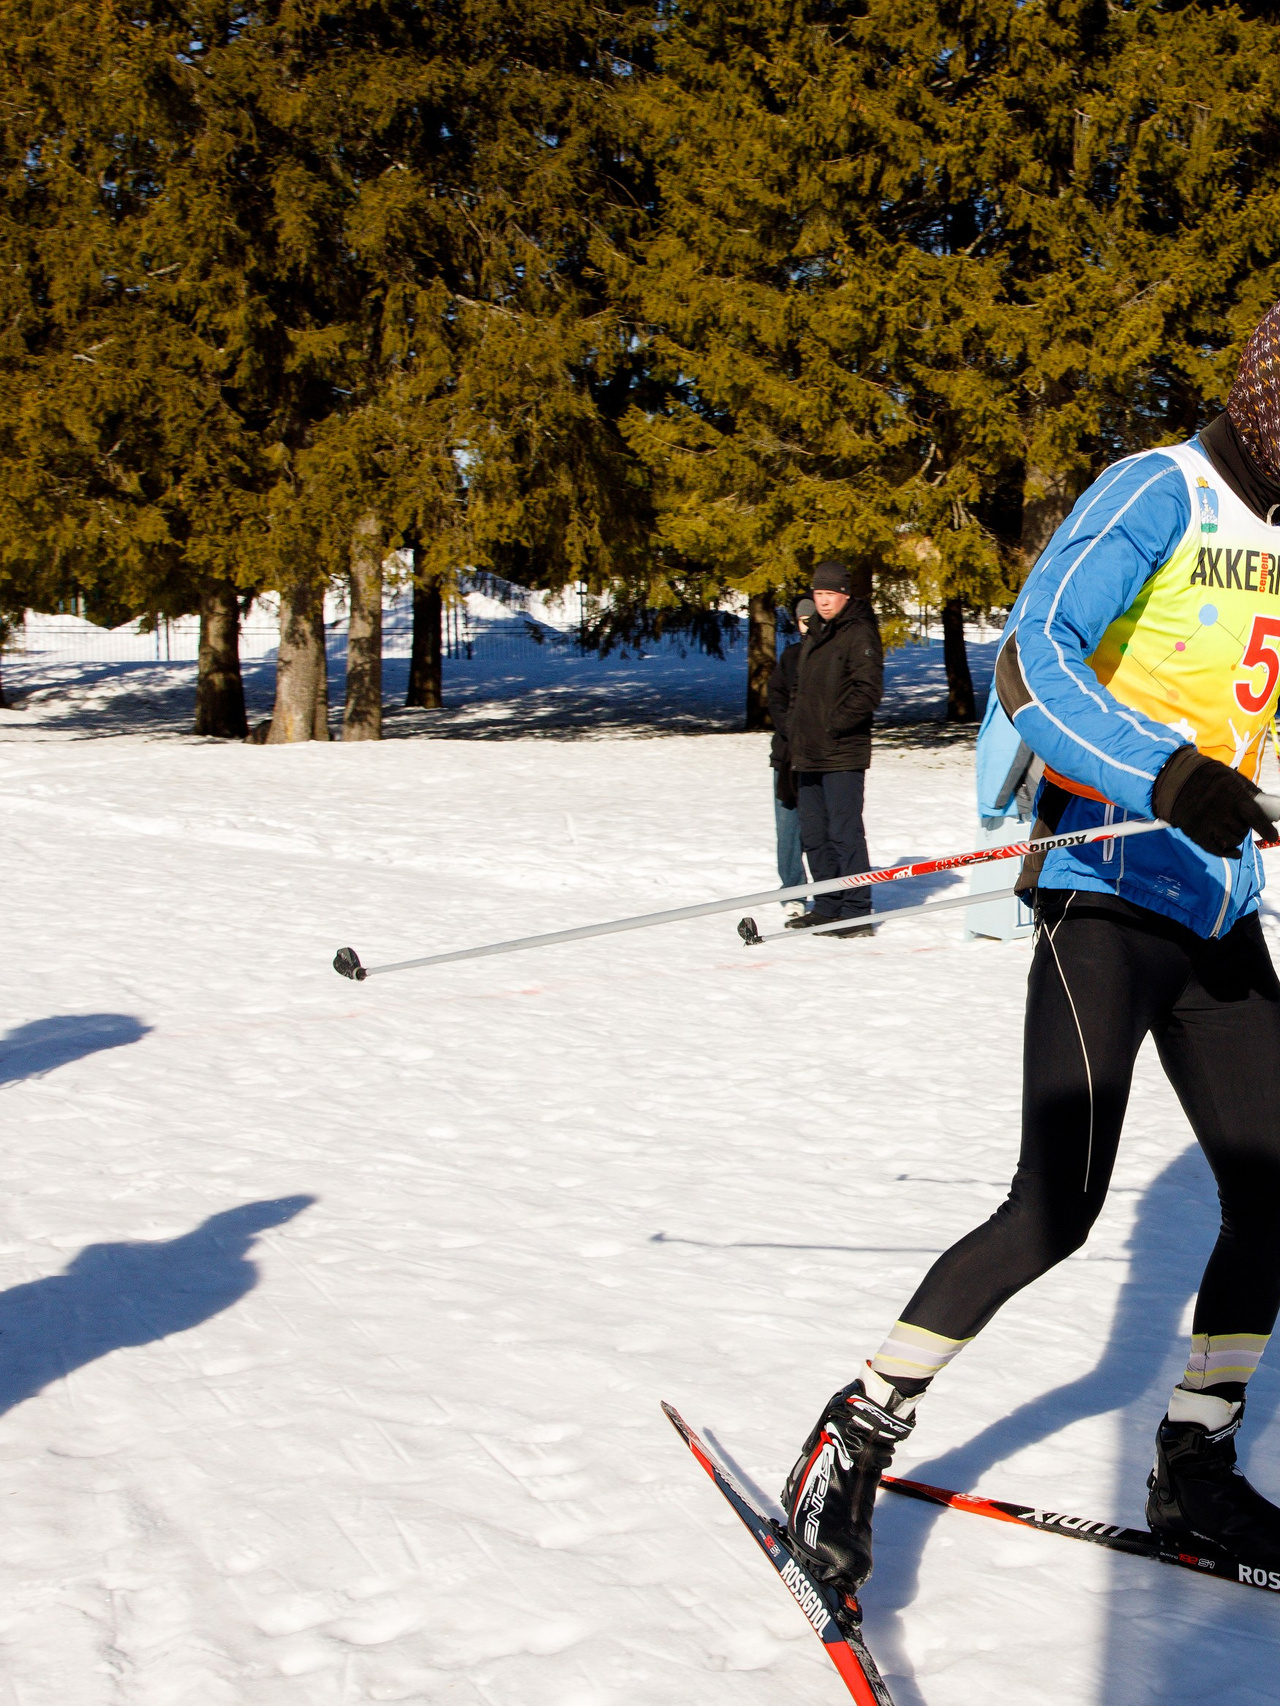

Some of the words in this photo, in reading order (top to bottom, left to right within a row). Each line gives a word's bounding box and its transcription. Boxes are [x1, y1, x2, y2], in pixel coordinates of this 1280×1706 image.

[1259, 552, 1270, 593] cement
[1029, 834, 1087, 853] Acadia
[804, 1450, 831, 1550] SPINE
[779, 1557, 832, 1639] ROSSIGNOL
